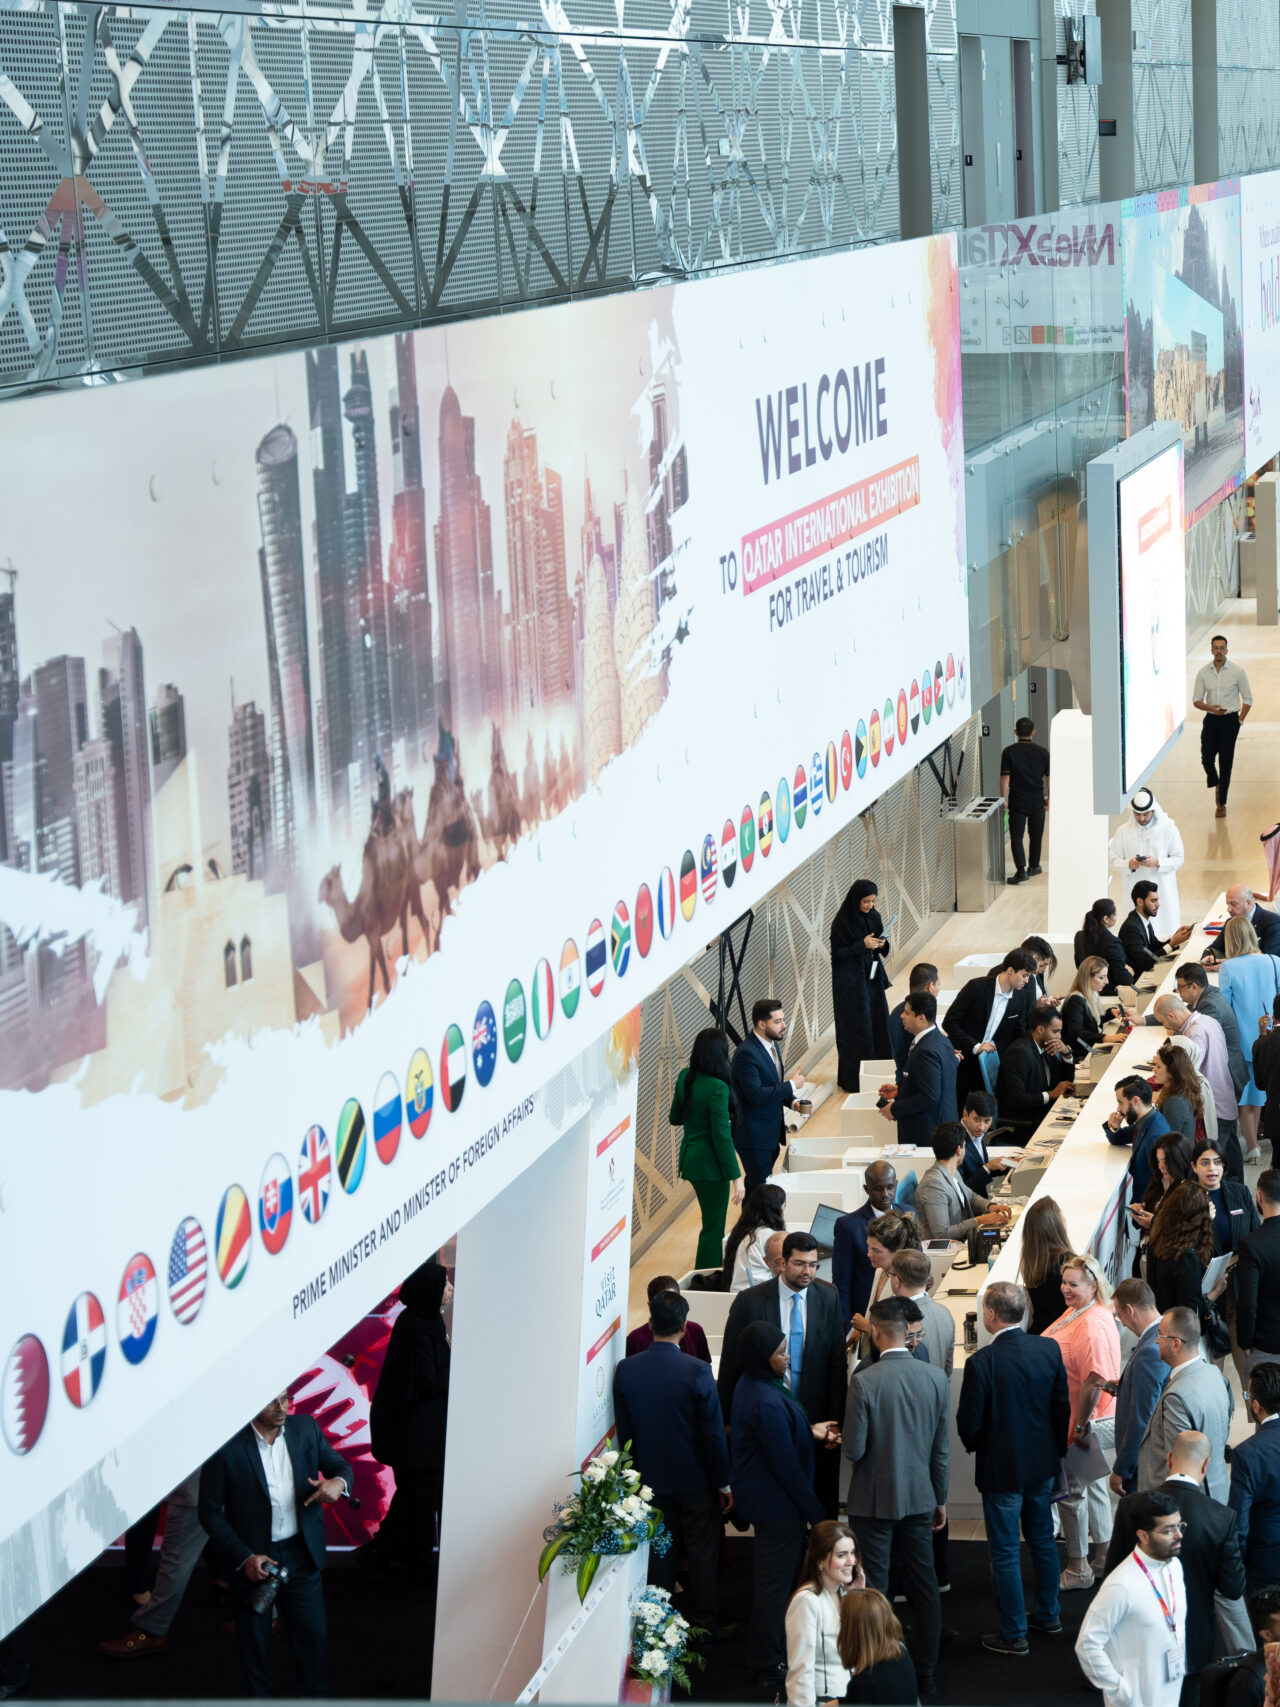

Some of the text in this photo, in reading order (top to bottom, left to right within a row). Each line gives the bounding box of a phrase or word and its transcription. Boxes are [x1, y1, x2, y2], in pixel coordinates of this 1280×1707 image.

[756, 357, 887, 485] WELCOME
[720, 463, 919, 594] TO QATAR INTERNATIONAL EXHIBITION
[770, 533, 889, 632] FOR TRAVEL & TOURISM
[292, 1094, 534, 1319] PRIME MINISTER AND MINISTER OF FOREIGN AFFAIRS
[595, 1281, 617, 1318] QATAR
[600, 1265, 616, 1292] visit
